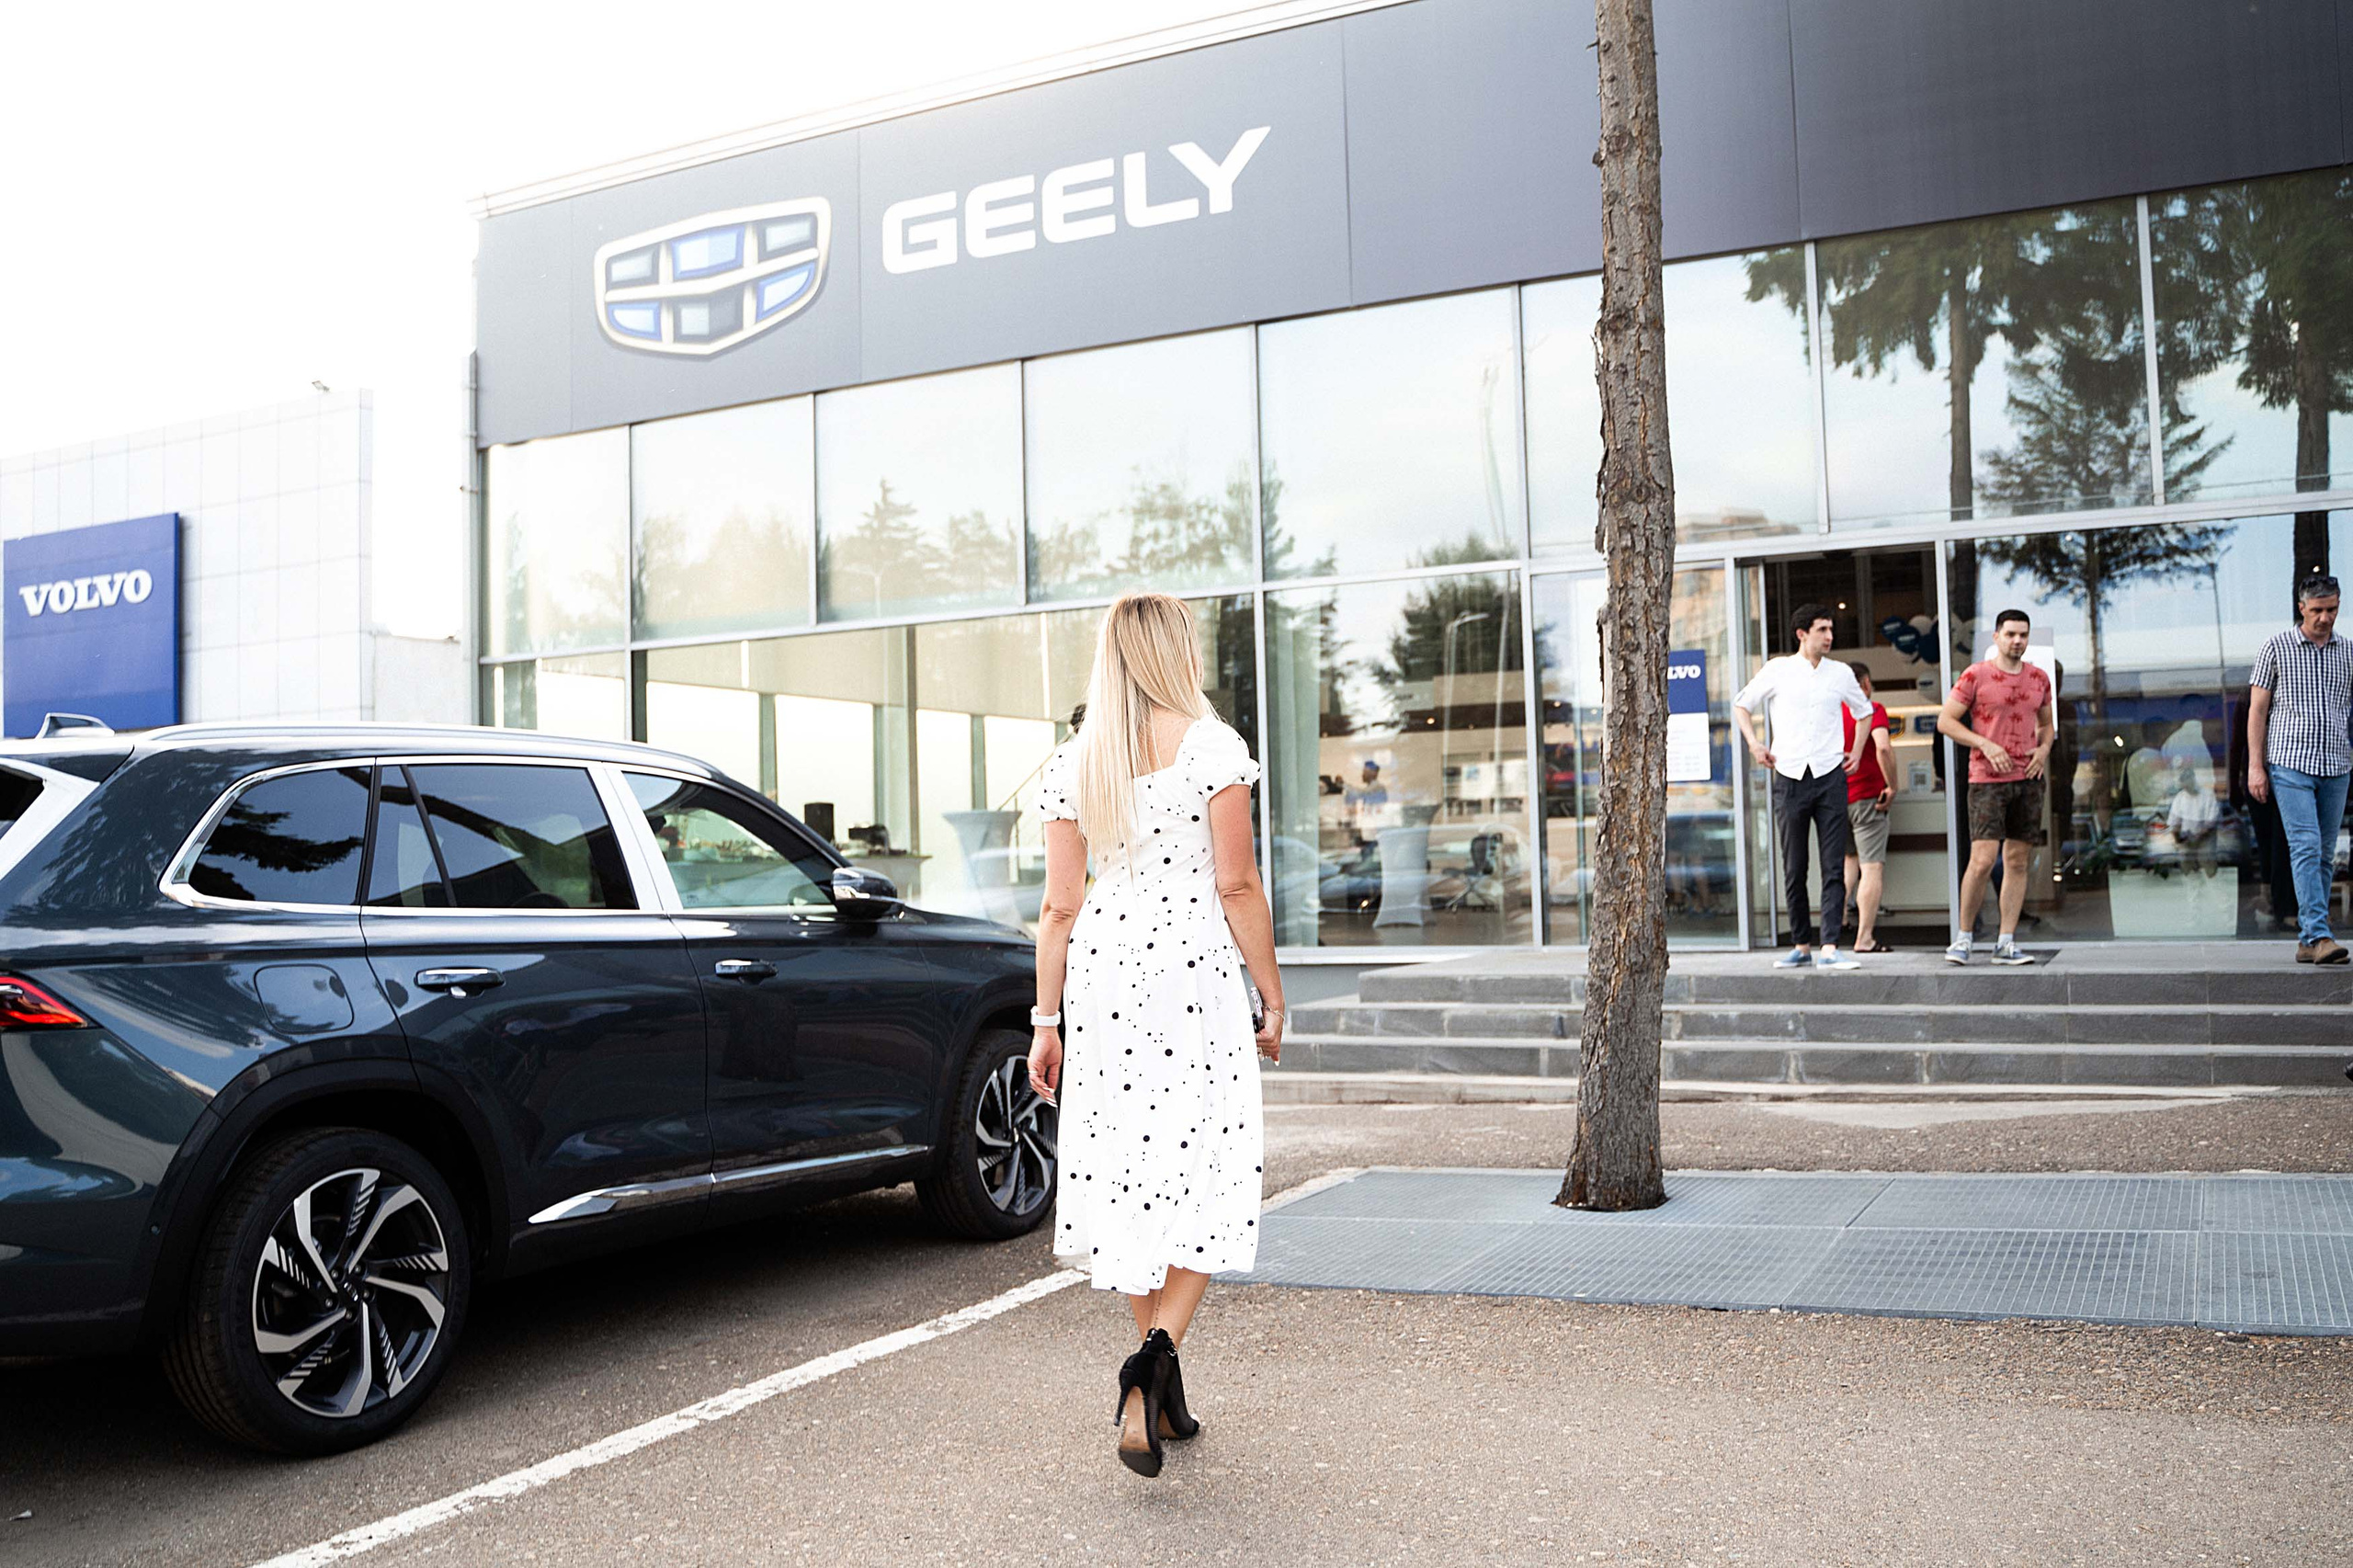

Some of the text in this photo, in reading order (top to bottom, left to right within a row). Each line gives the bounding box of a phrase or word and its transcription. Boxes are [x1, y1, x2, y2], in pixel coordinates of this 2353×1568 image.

[882, 126, 1271, 275] GEELY
[18, 568, 153, 617] VOLVO
[1667, 665, 1701, 680] LVO
